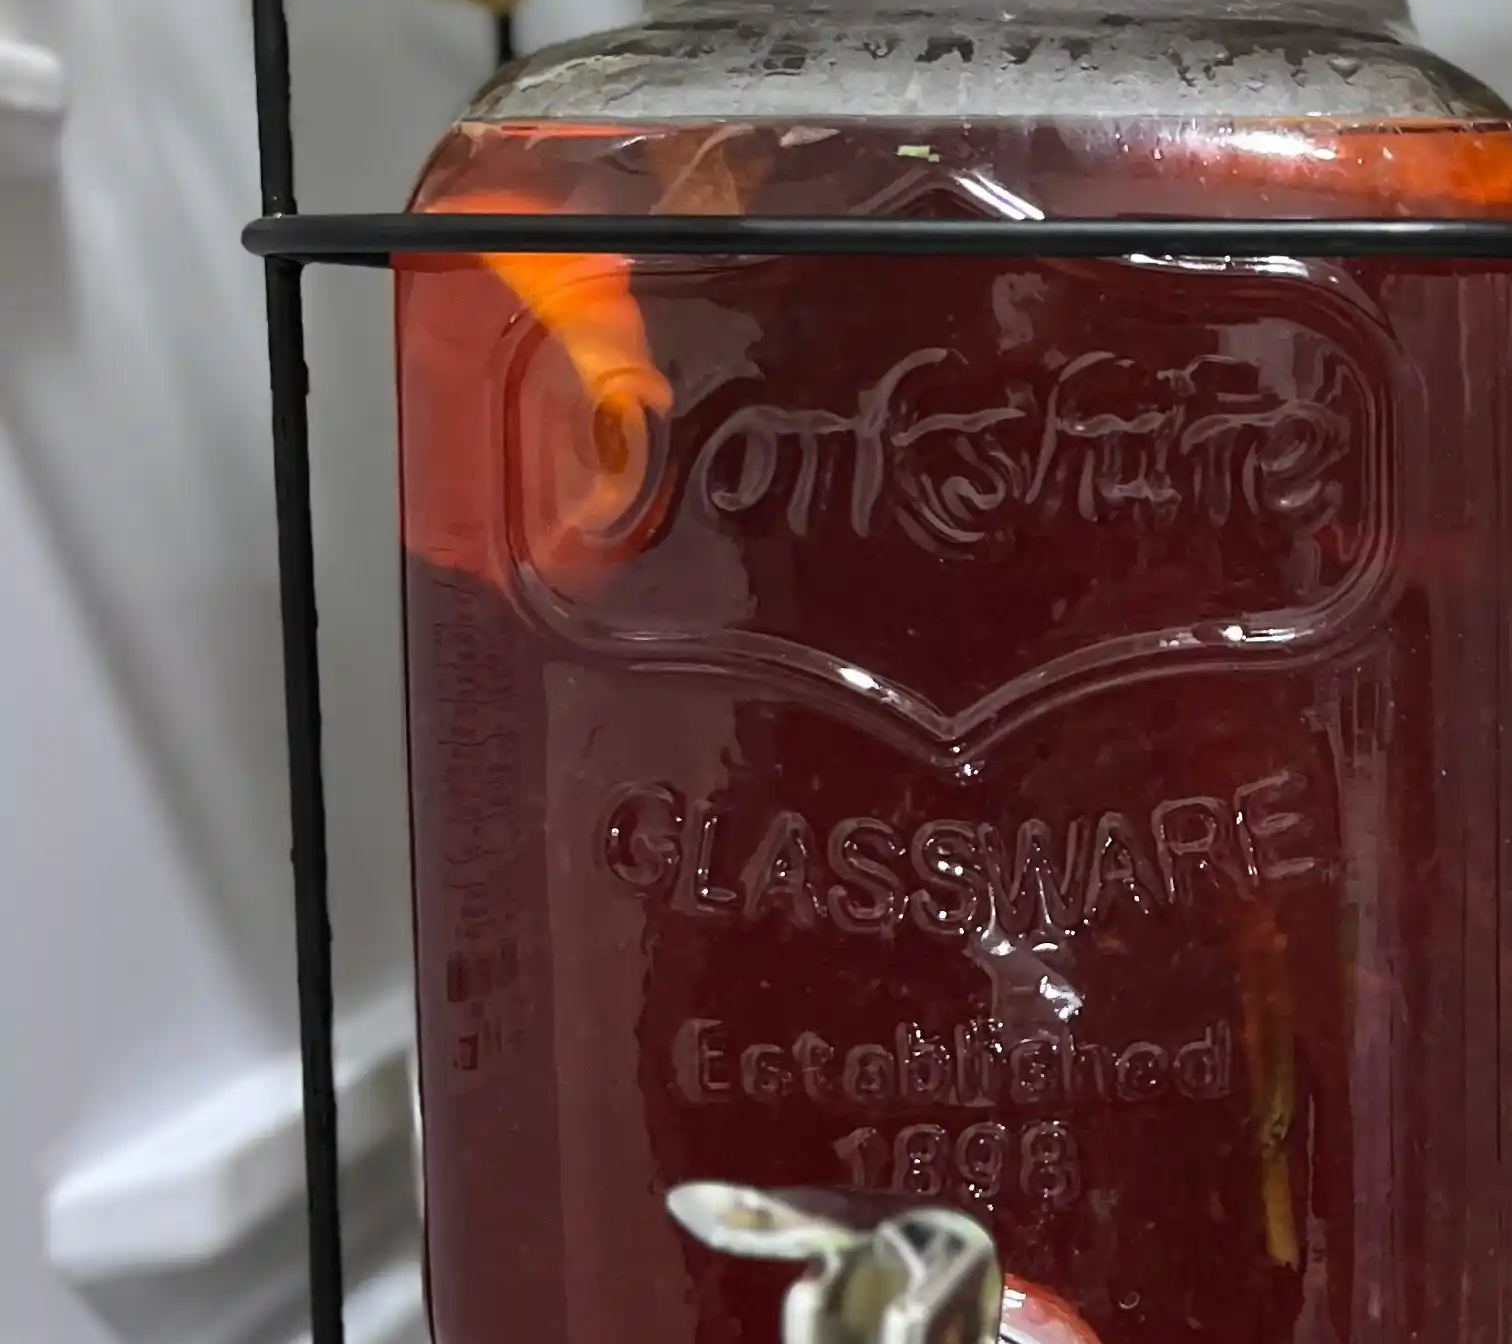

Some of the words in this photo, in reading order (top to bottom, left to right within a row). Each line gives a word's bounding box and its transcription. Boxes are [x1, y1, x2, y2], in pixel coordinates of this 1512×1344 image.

[598, 770, 1328, 934] GLASSWARE
[671, 1016, 1236, 1106] Established
[836, 1120, 1078, 1206] 1898
